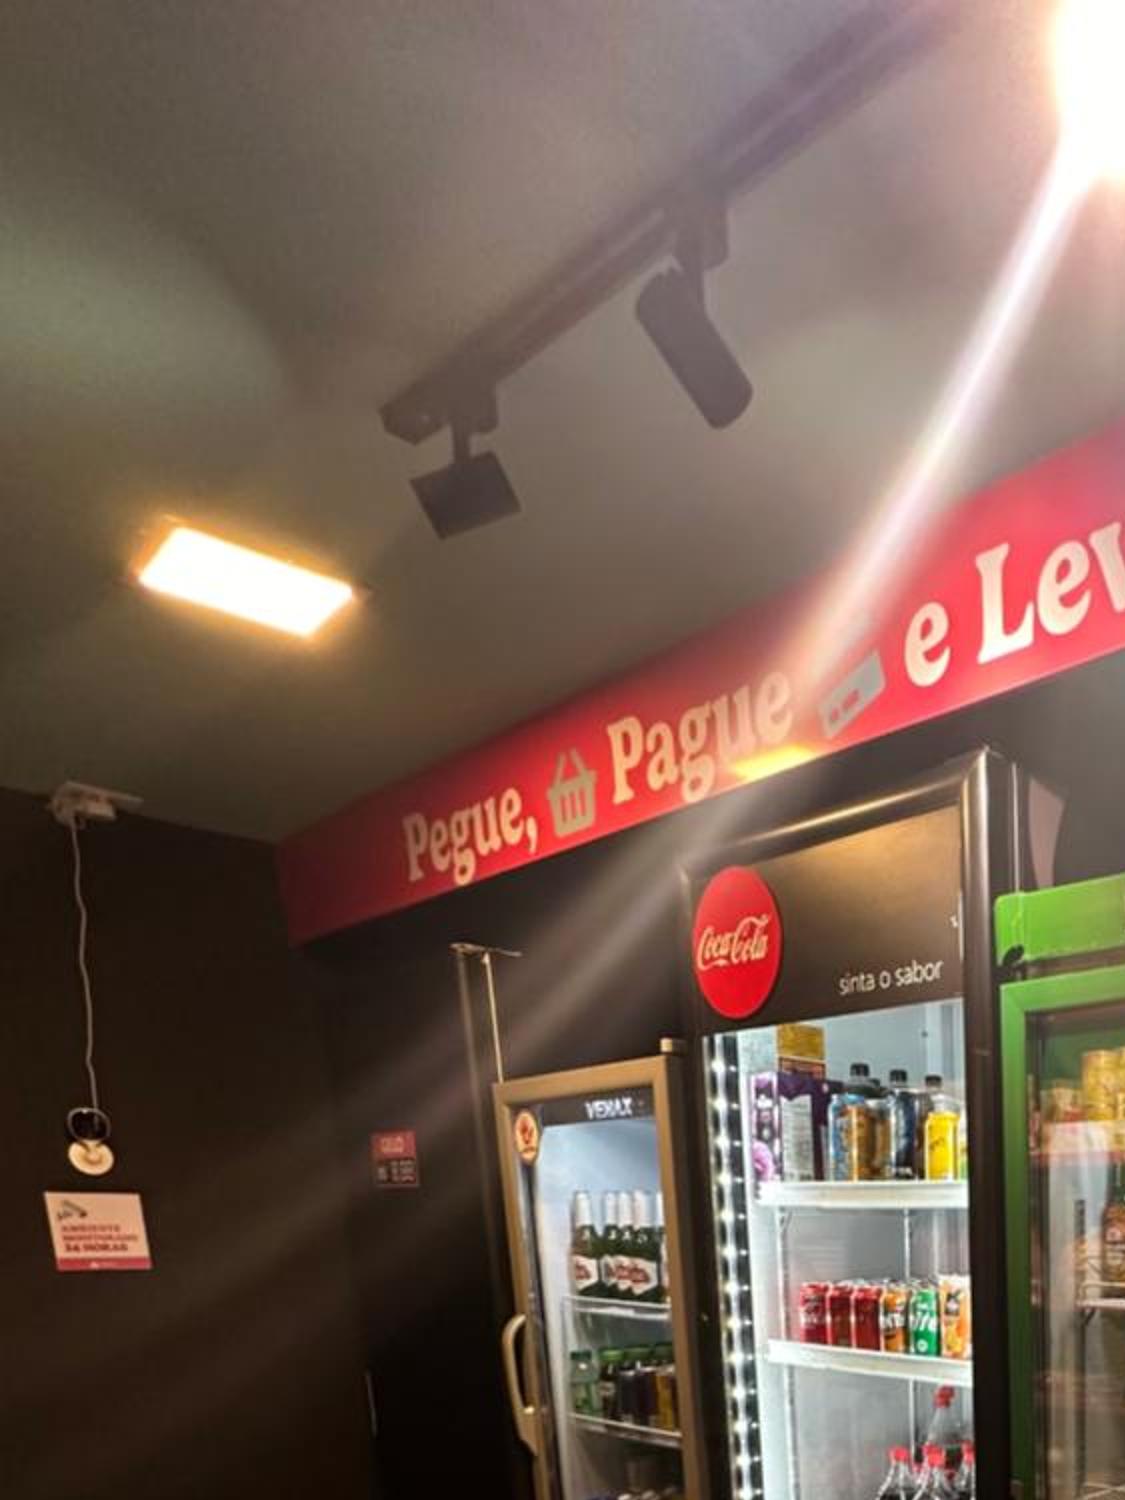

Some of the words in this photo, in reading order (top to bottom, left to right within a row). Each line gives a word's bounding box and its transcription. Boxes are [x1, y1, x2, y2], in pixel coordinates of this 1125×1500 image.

[403, 785, 538, 886] Pegue,
[605, 671, 795, 804] Pague
[904, 602, 951, 688] e
[838, 972, 876, 996] sinta
[878, 969, 892, 989] o
[894, 959, 944, 987] sabor
